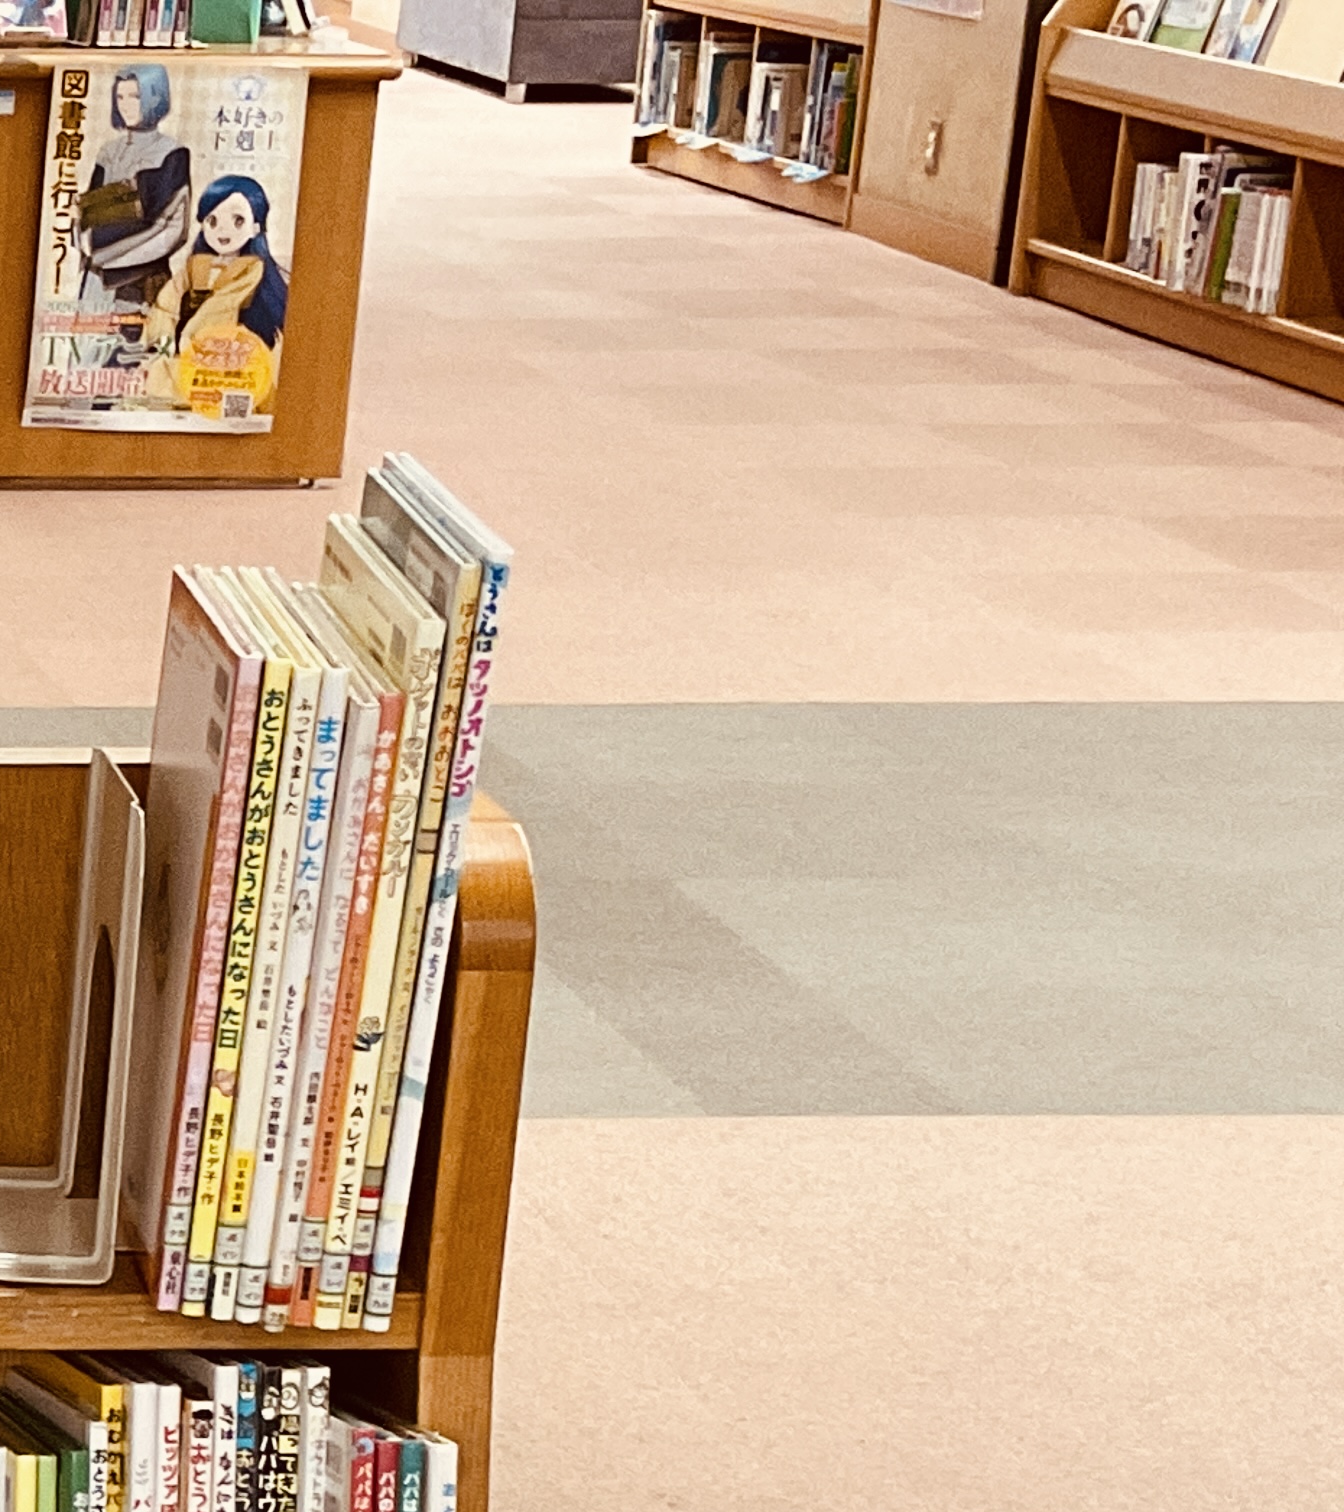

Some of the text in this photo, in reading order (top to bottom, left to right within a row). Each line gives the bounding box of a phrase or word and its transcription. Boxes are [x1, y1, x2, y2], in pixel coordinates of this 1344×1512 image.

[282, 698, 313, 817] ふってきました
[297, 715, 342, 883] まってました
[450, 659, 491, 799] タツノオトシゴ
[216, 688, 286, 1049] おとうさんがおとうさんになった日
[383, 792, 418, 899] カンガルー
